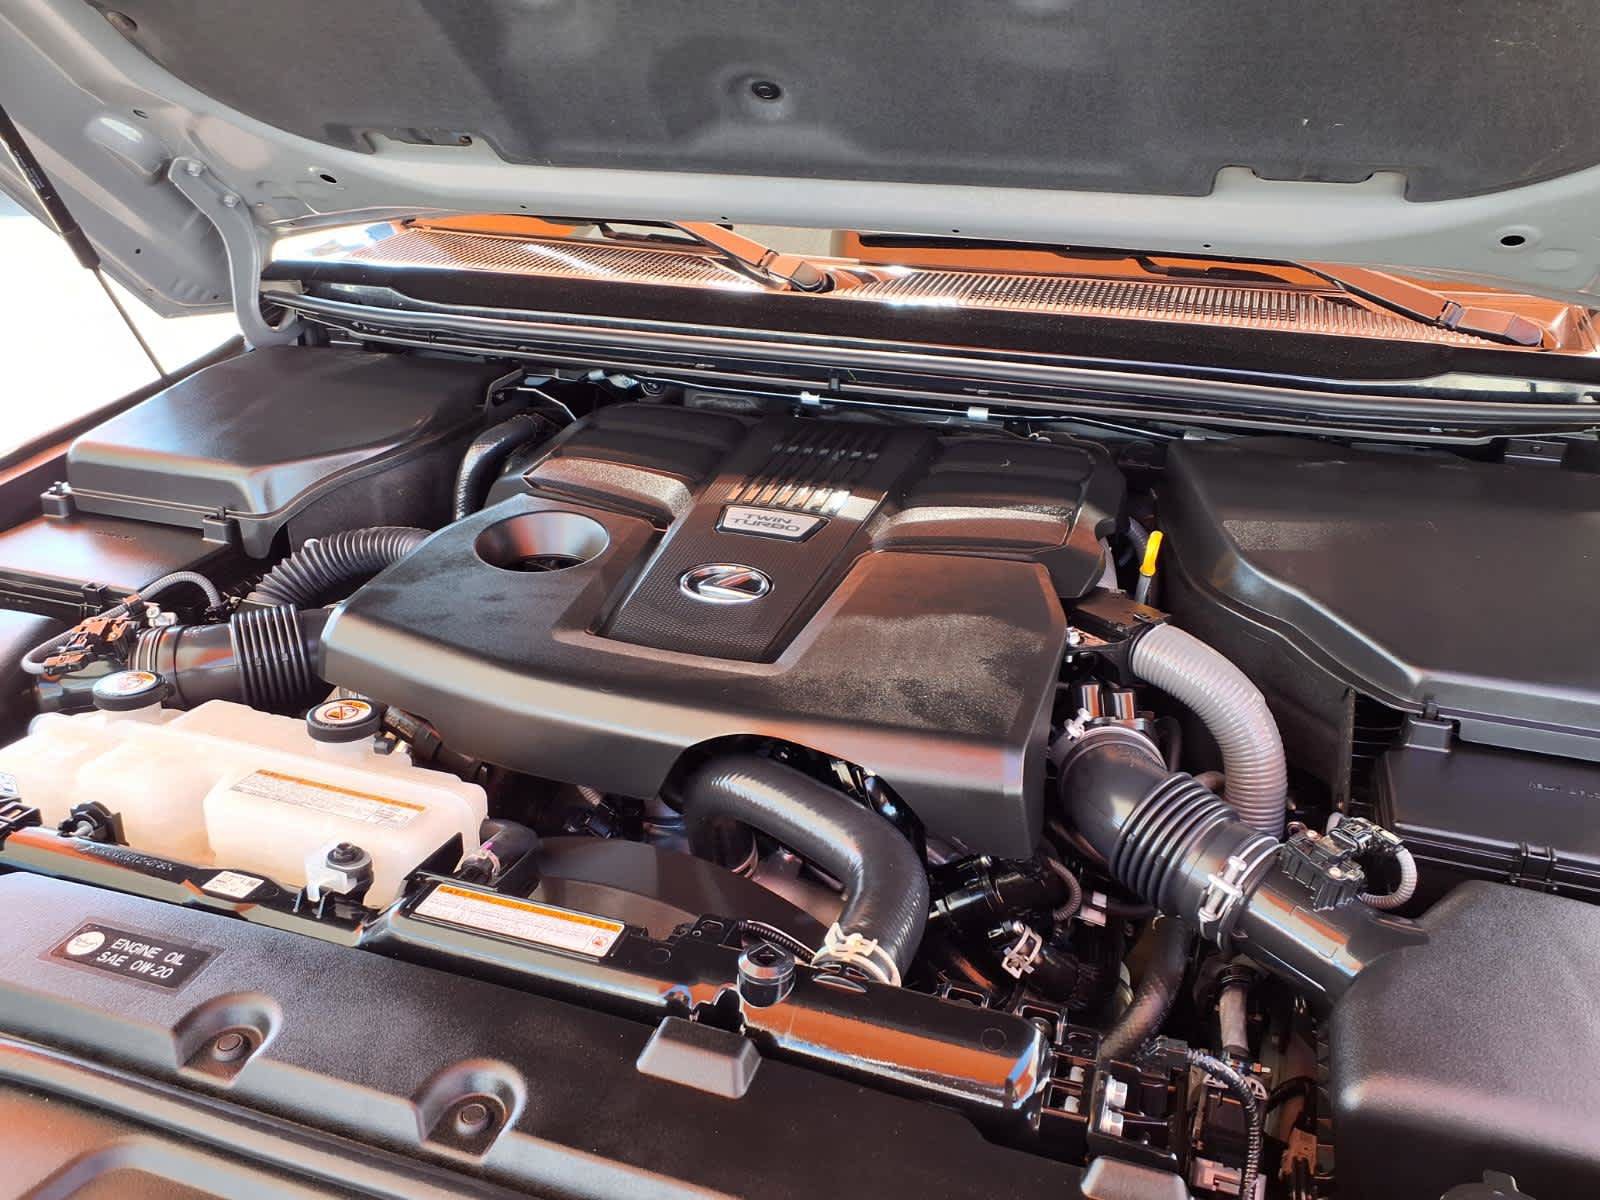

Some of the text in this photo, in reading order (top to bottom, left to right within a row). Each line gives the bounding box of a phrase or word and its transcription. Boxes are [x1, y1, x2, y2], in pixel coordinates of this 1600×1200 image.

[733, 518, 801, 532] TURBO
[743, 513, 792, 524] TWIN
[110, 938, 162, 959] ENGINE
[164, 951, 186, 966] OIL
[97, 951, 174, 979] SAE 0W-20
